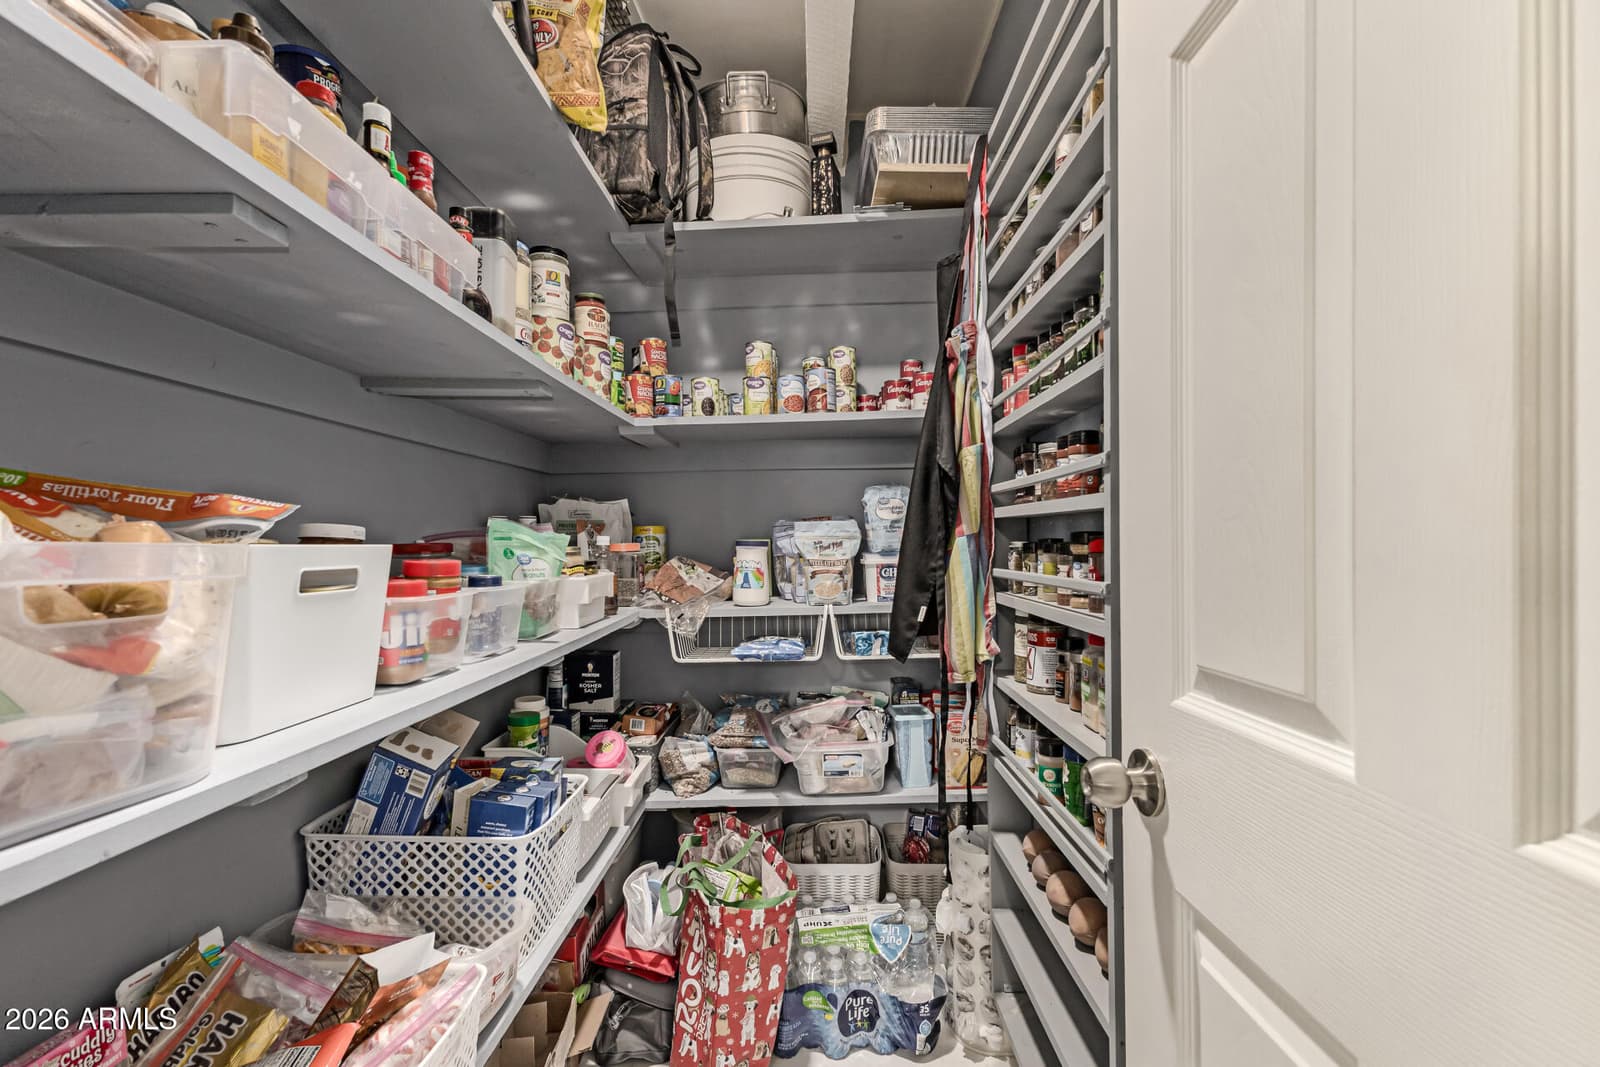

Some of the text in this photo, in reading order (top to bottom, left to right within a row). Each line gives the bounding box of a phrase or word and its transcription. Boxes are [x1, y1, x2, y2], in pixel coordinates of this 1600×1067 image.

[40, 481, 176, 512] Flour Tortillas
[845, 996, 873, 1012] Pure
[919, 1004, 930, 1014] 35
[848, 1006, 870, 1022] Life
